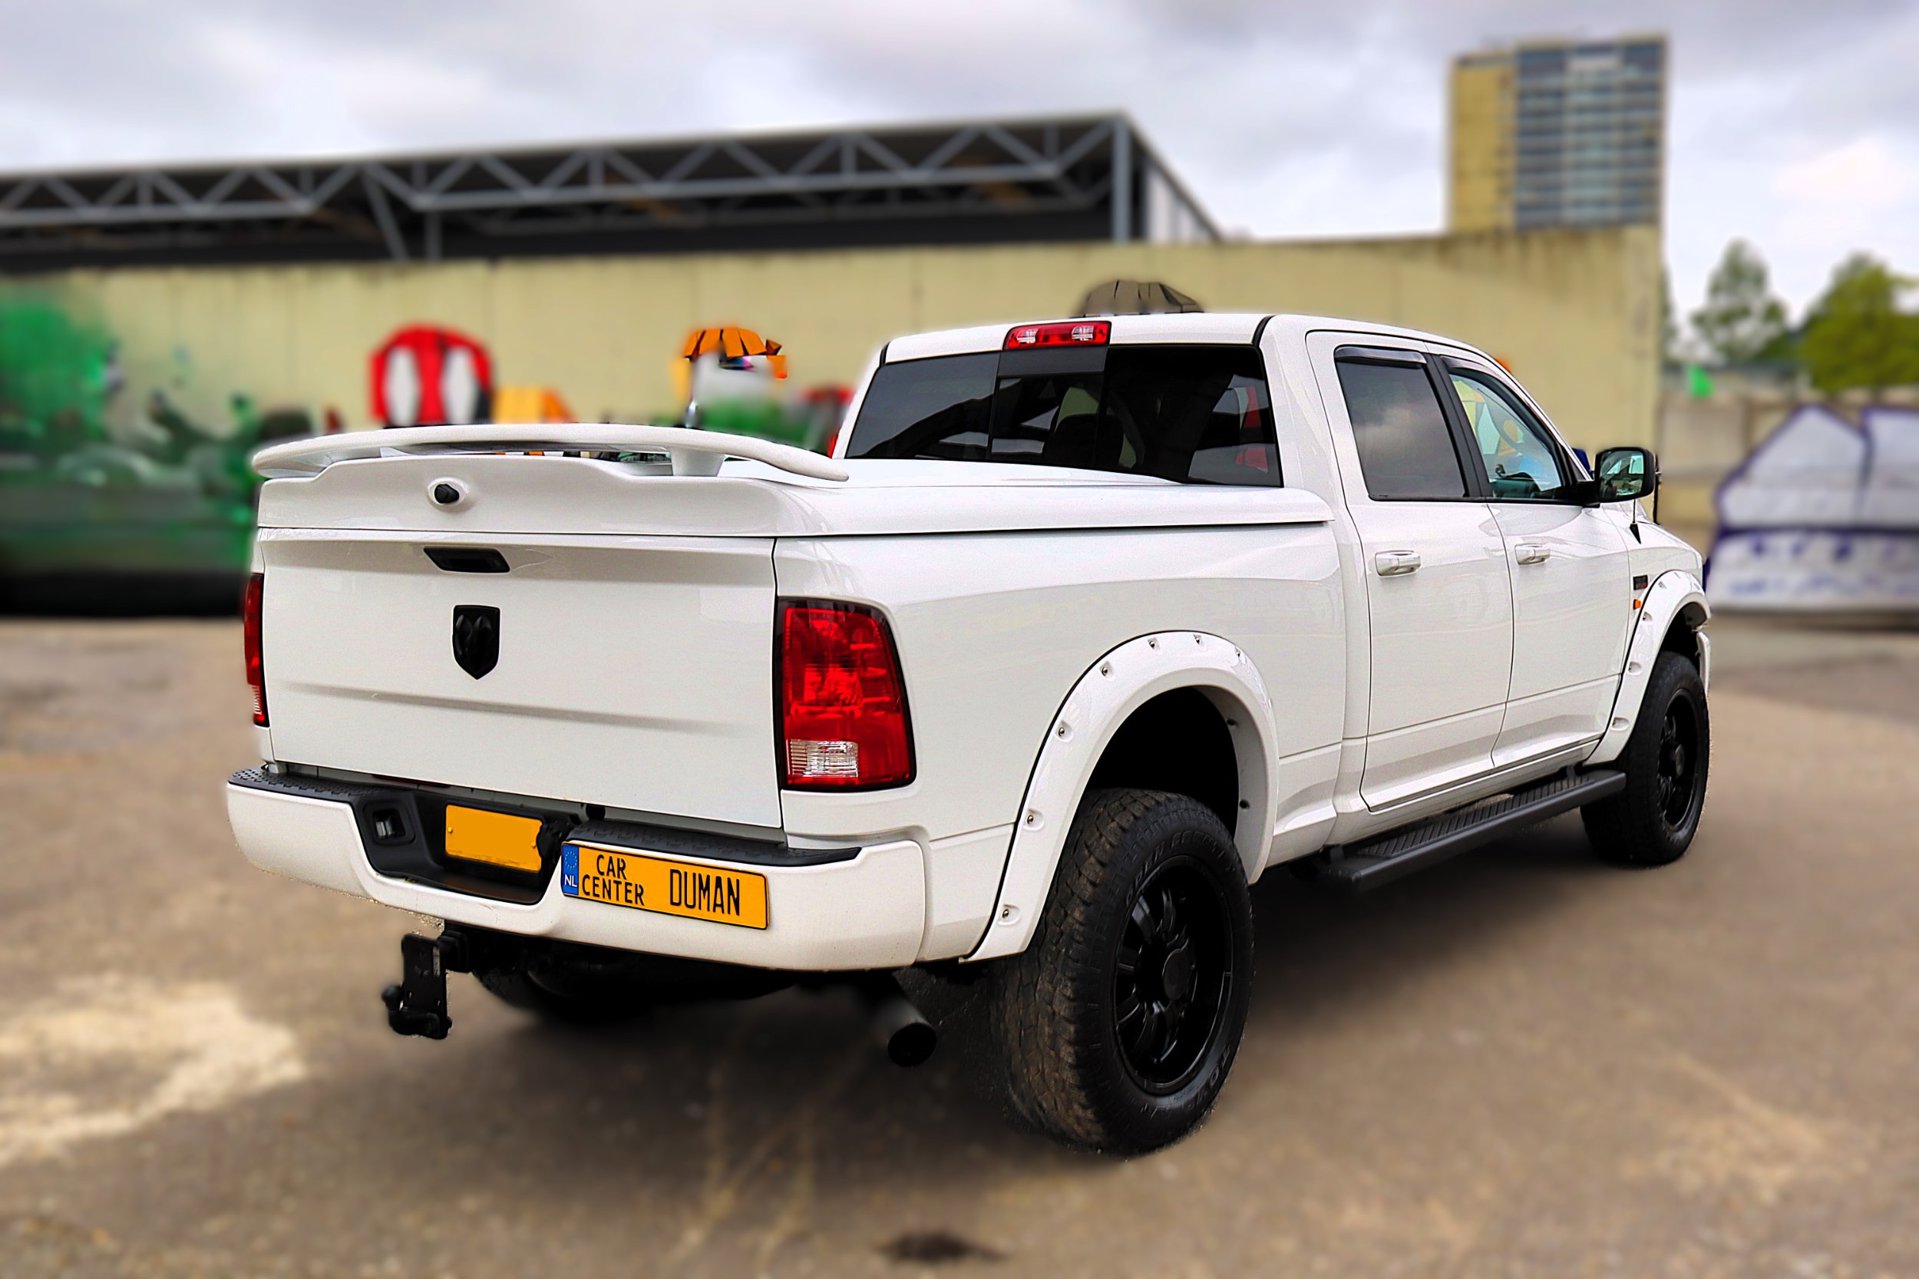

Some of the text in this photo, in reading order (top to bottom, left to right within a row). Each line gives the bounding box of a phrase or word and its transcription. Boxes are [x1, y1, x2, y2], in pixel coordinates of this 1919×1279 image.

[564, 874, 578, 888] NL
[596, 854, 627, 880] CAR
[582, 874, 645, 906] CENTER
[669, 868, 741, 916] DUMAN
